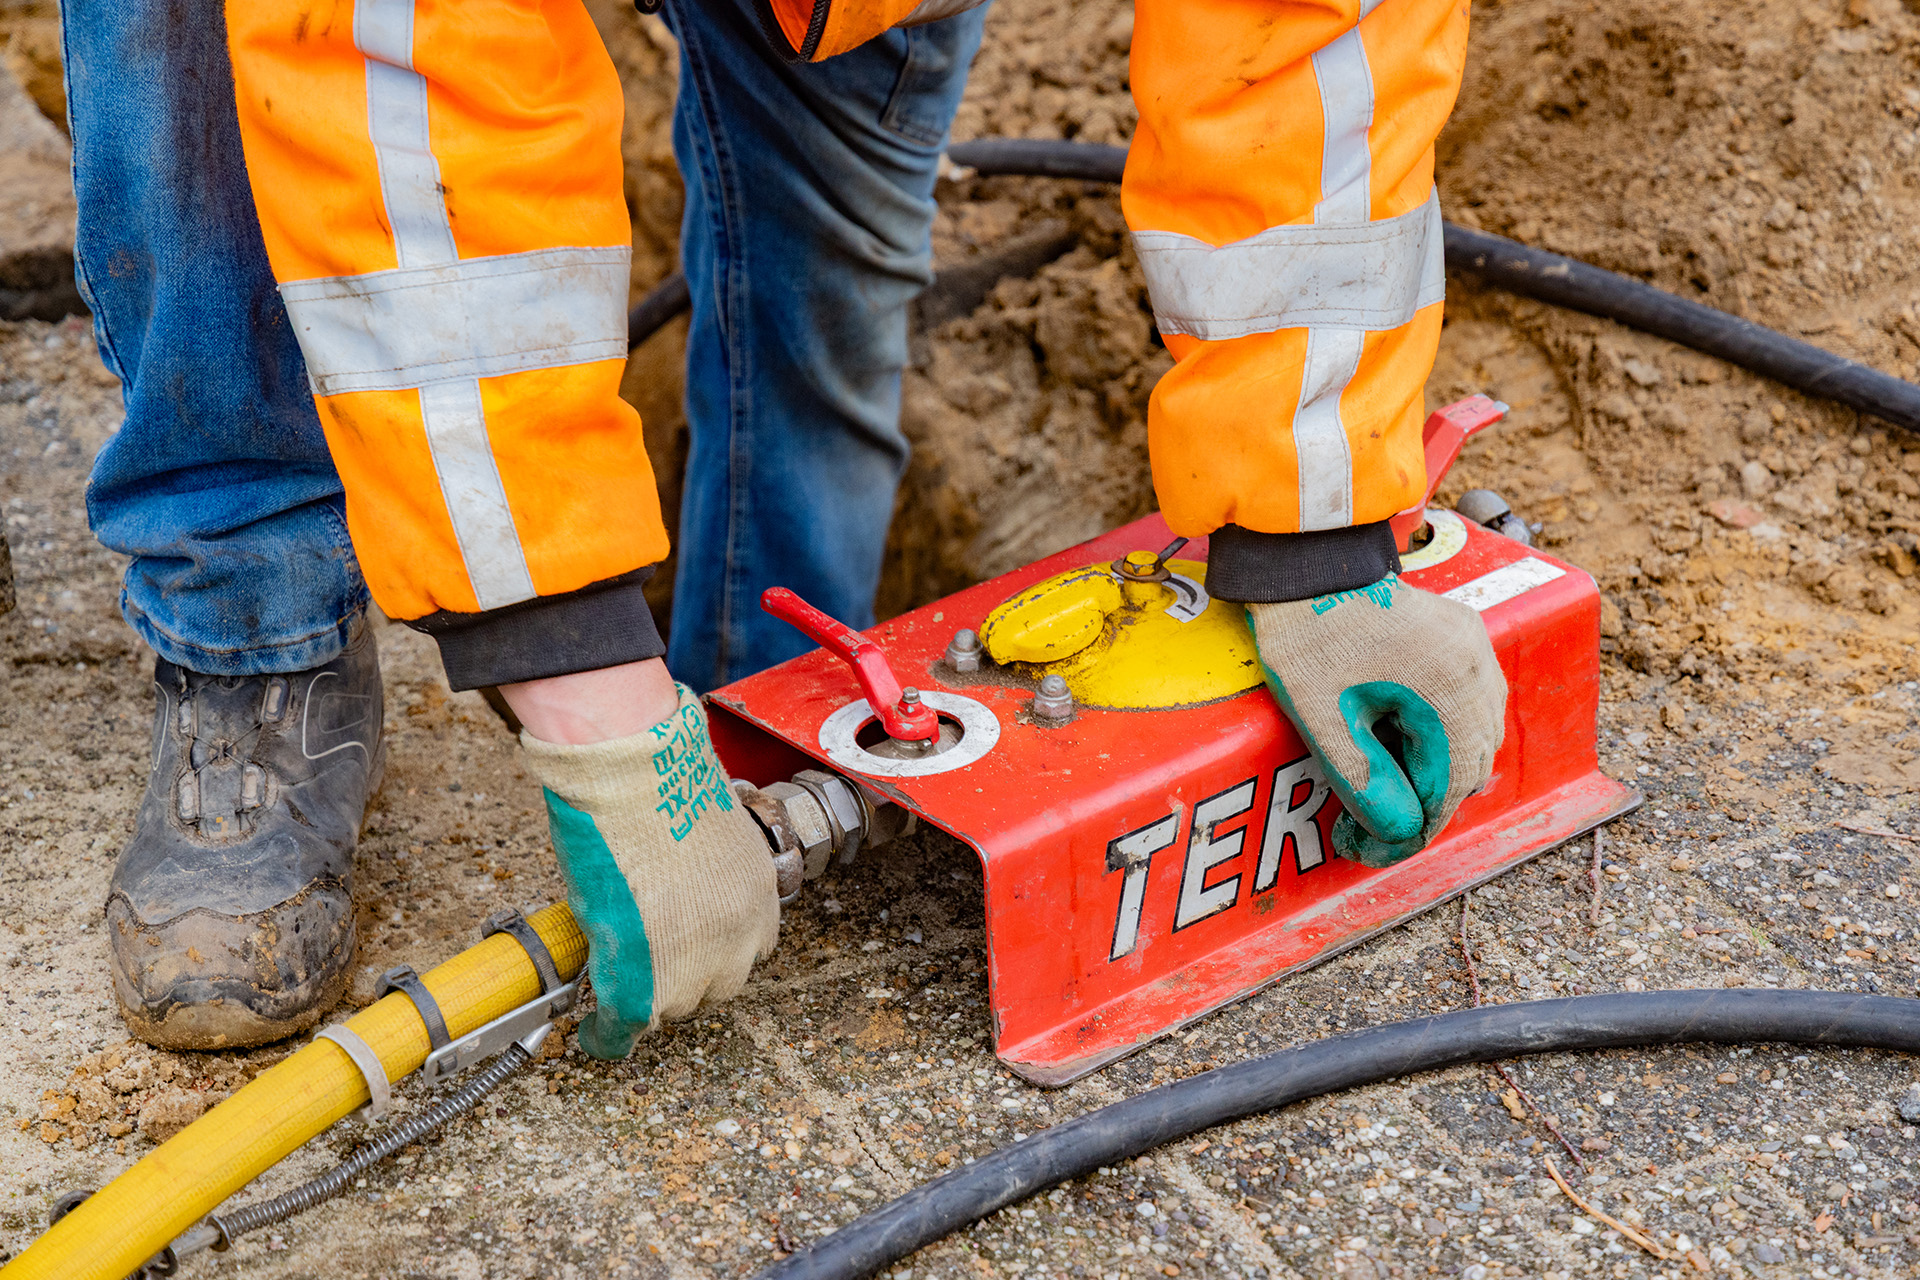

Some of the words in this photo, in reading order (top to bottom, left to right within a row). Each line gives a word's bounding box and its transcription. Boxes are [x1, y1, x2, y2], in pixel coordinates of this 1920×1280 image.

[656, 755, 708, 819] 10/XL
[670, 765, 721, 841] OWA
[1104, 754, 1338, 963] TER
